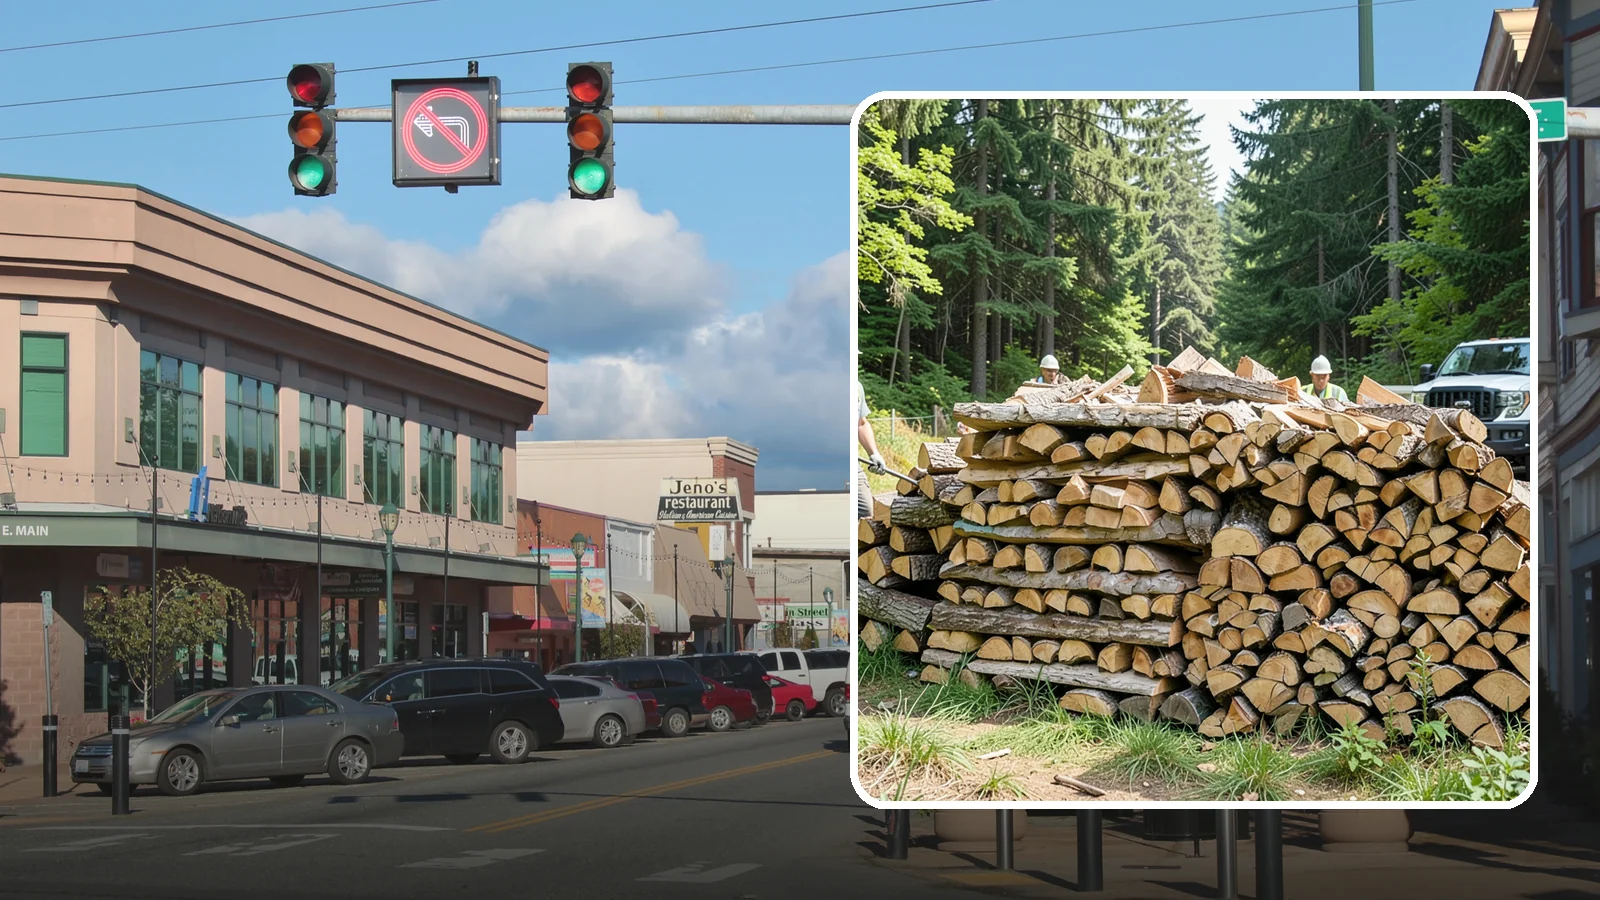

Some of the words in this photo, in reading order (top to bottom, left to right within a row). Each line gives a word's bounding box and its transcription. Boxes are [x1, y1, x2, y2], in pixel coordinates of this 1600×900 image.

[670, 480, 727, 494] Jeno's
[665, 496, 731, 509] restaurant
[658, 510, 682, 519] Italian
[686, 509, 715, 519] American
[715, 509, 738, 519] Cuisine
[2, 525, 13, 536] E.
[15, 525, 49, 536] MAIN
[797, 608, 828, 616] Street
[791, 619, 823, 627] lass
